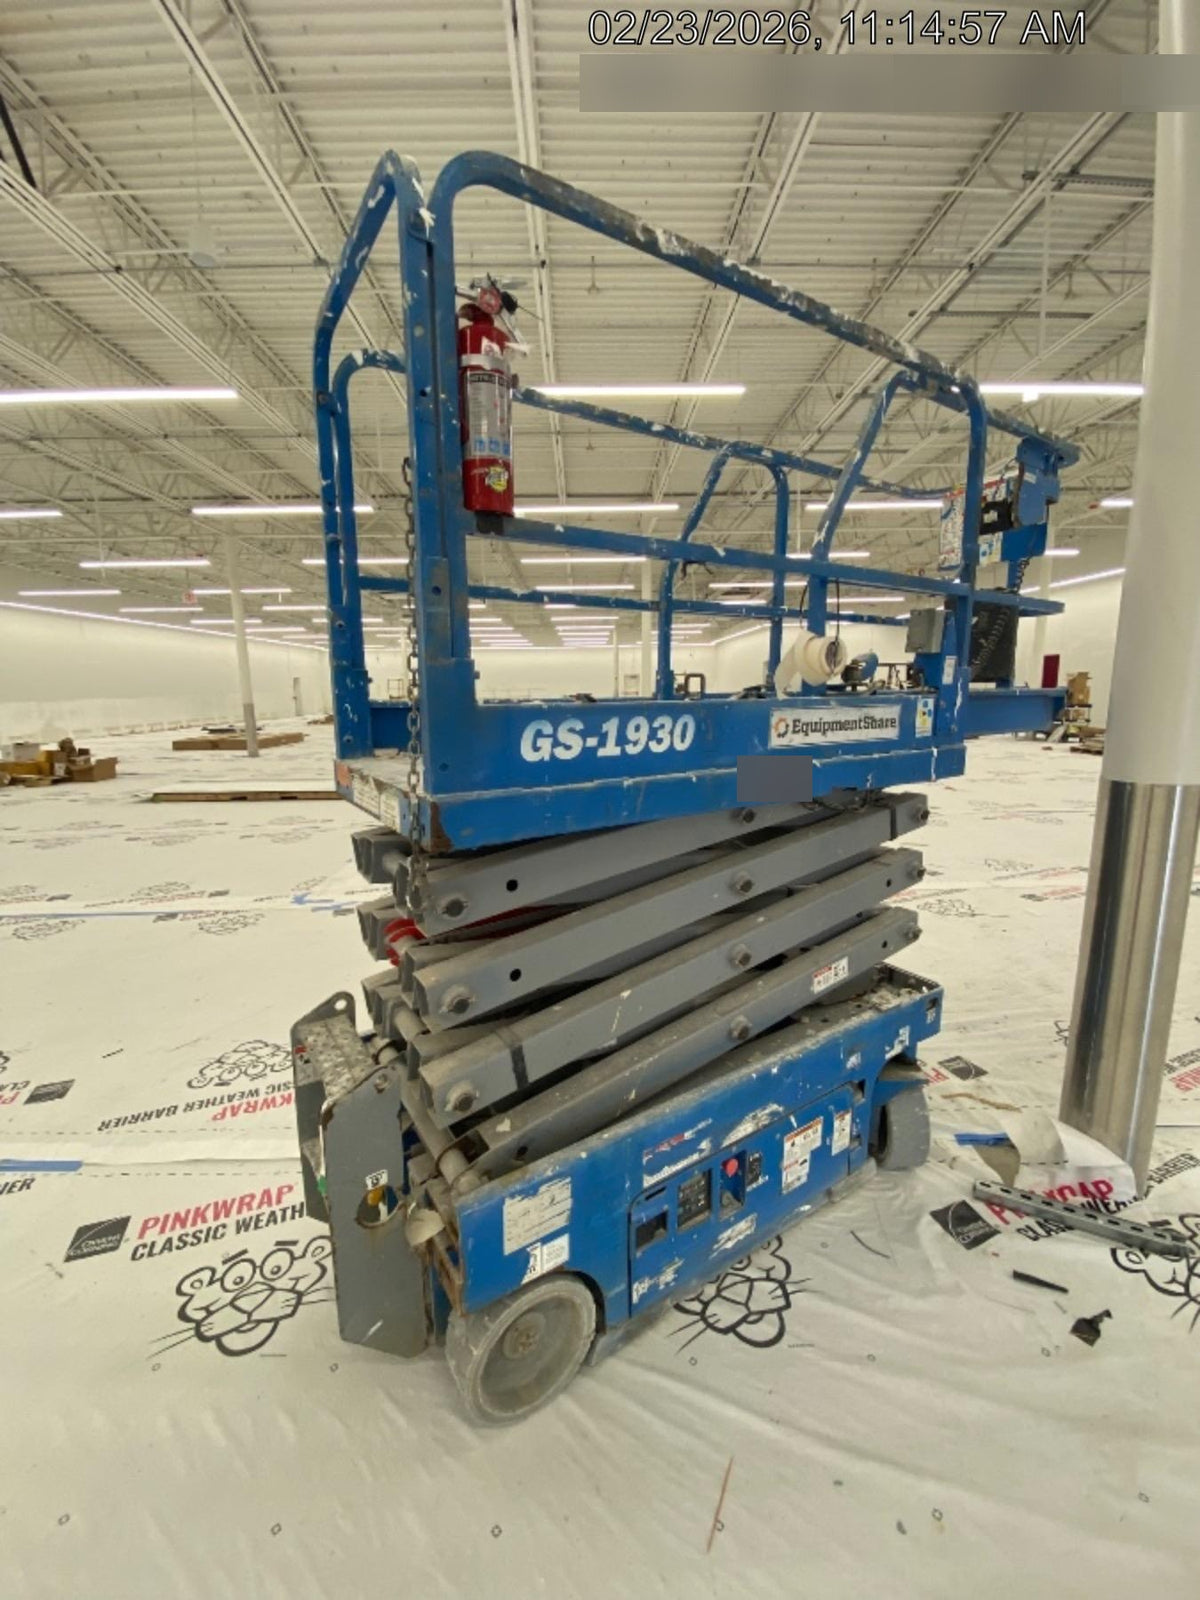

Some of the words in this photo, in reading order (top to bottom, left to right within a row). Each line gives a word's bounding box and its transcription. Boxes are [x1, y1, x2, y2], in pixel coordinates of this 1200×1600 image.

[519, 714, 695, 763] GS-1930
[791, 715, 897, 737] EquipmentShare
[183, 1087, 260, 1113] WEATHER
[211, 1092, 294, 1121] KWRAP
[97, 1104, 179, 1132] BARRIER
[137, 1184, 294, 1240] PINKWRAP
[131, 1222, 227, 1262] CLASSIC
[235, 1201, 305, 1235] WEATH
